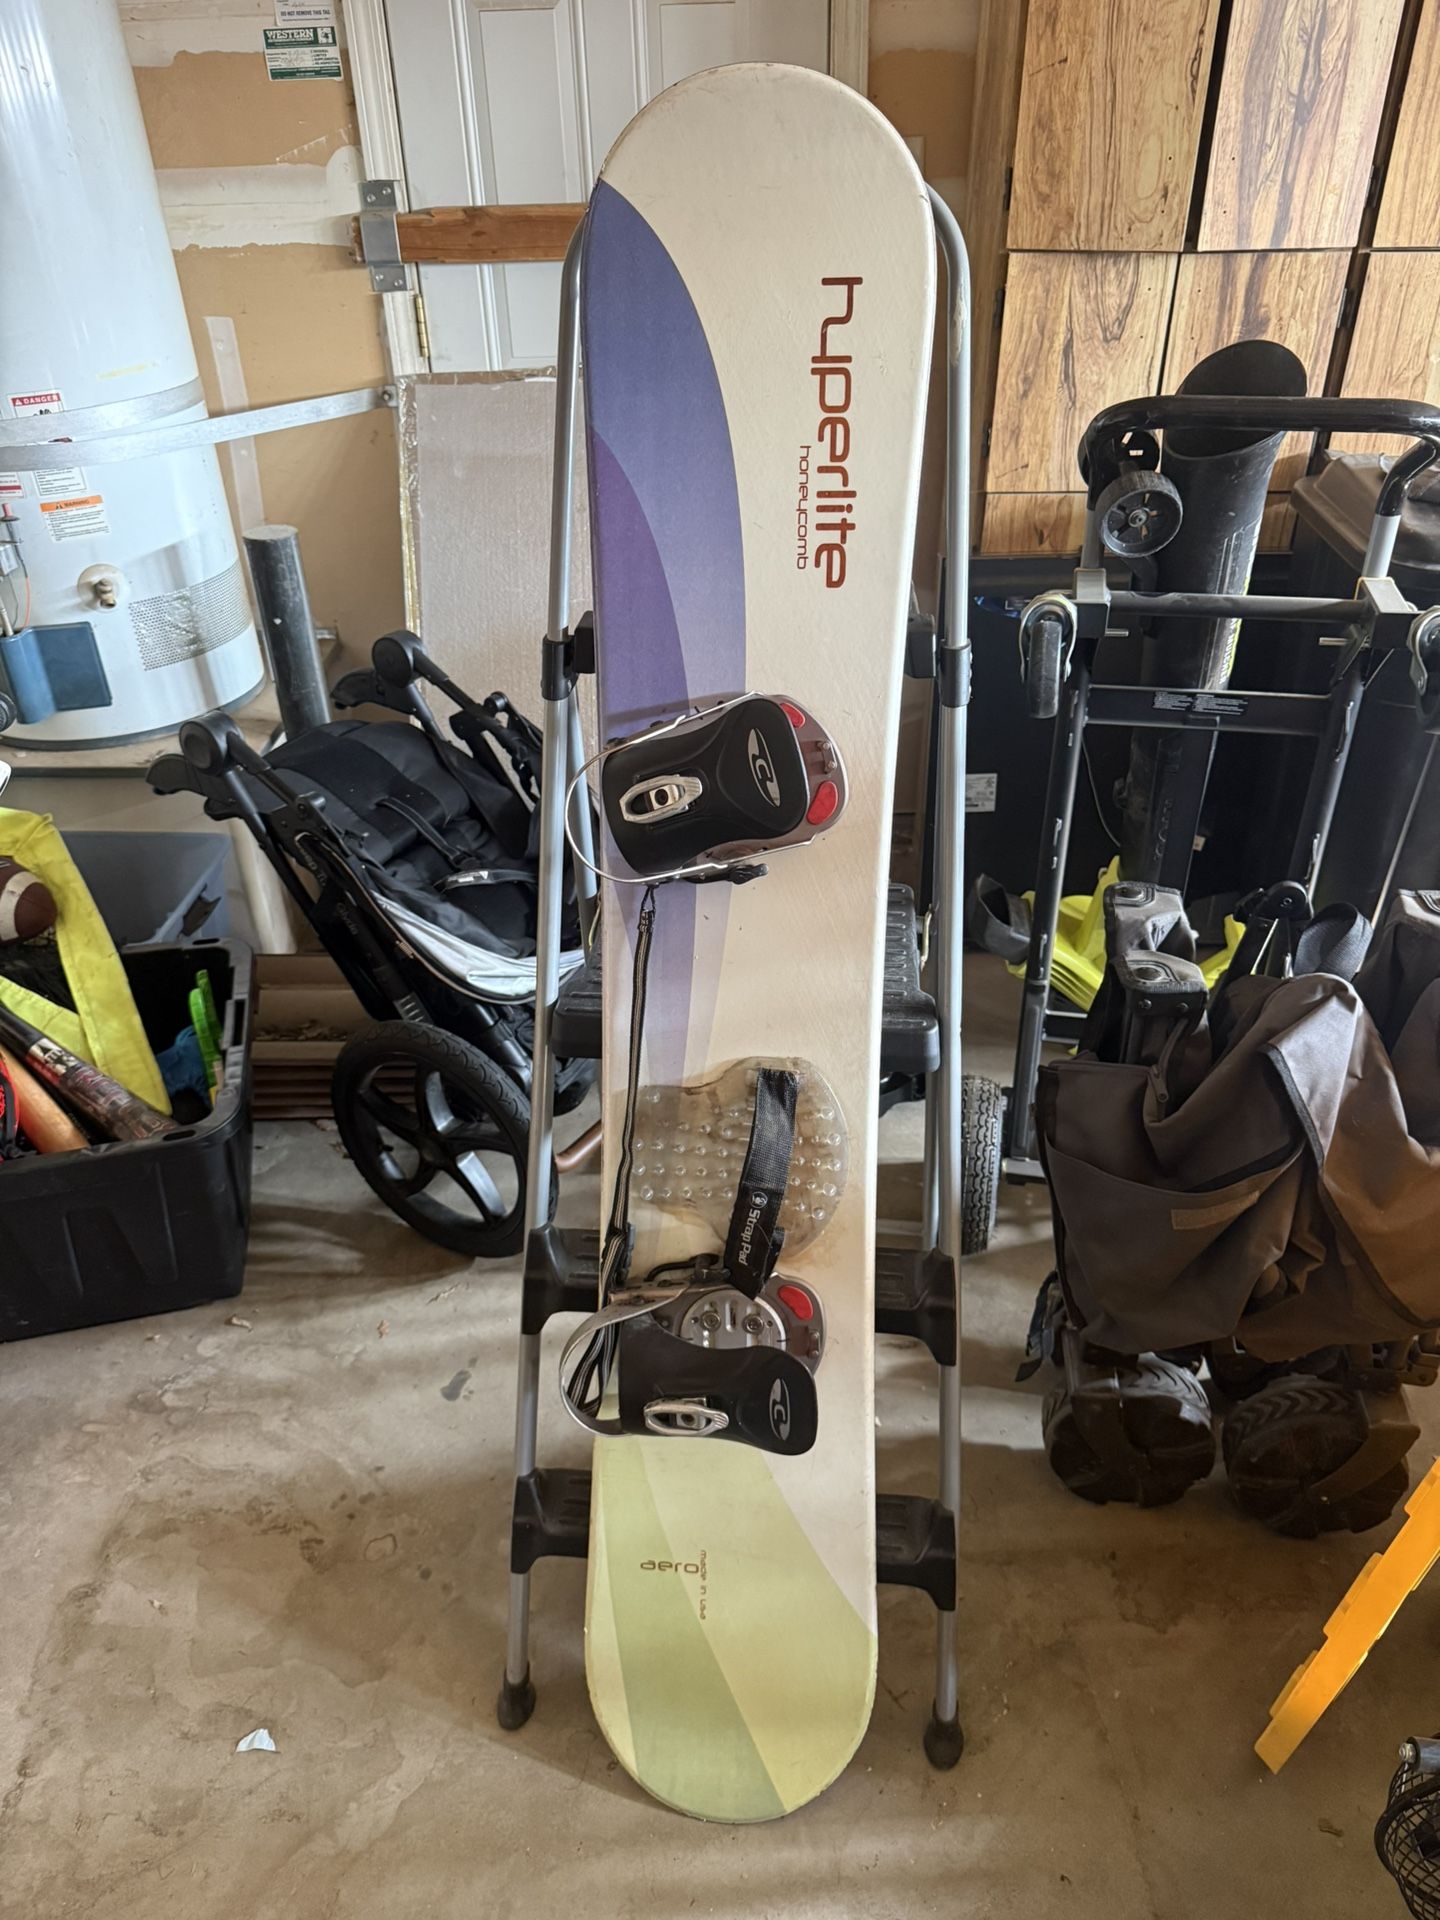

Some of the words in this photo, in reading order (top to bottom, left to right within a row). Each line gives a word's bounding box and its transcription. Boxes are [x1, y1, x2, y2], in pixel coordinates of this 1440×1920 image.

[266, 28, 314, 41] WESTERN
[23, 395, 58, 405] DANGER
[811, 277, 863, 588] hyperlite
[64, 499, 90, 507] WARNING
[796, 445, 812, 570] honeycomb
[740, 1208, 761, 1243] Strap
[640, 1559, 700, 1574] aero
